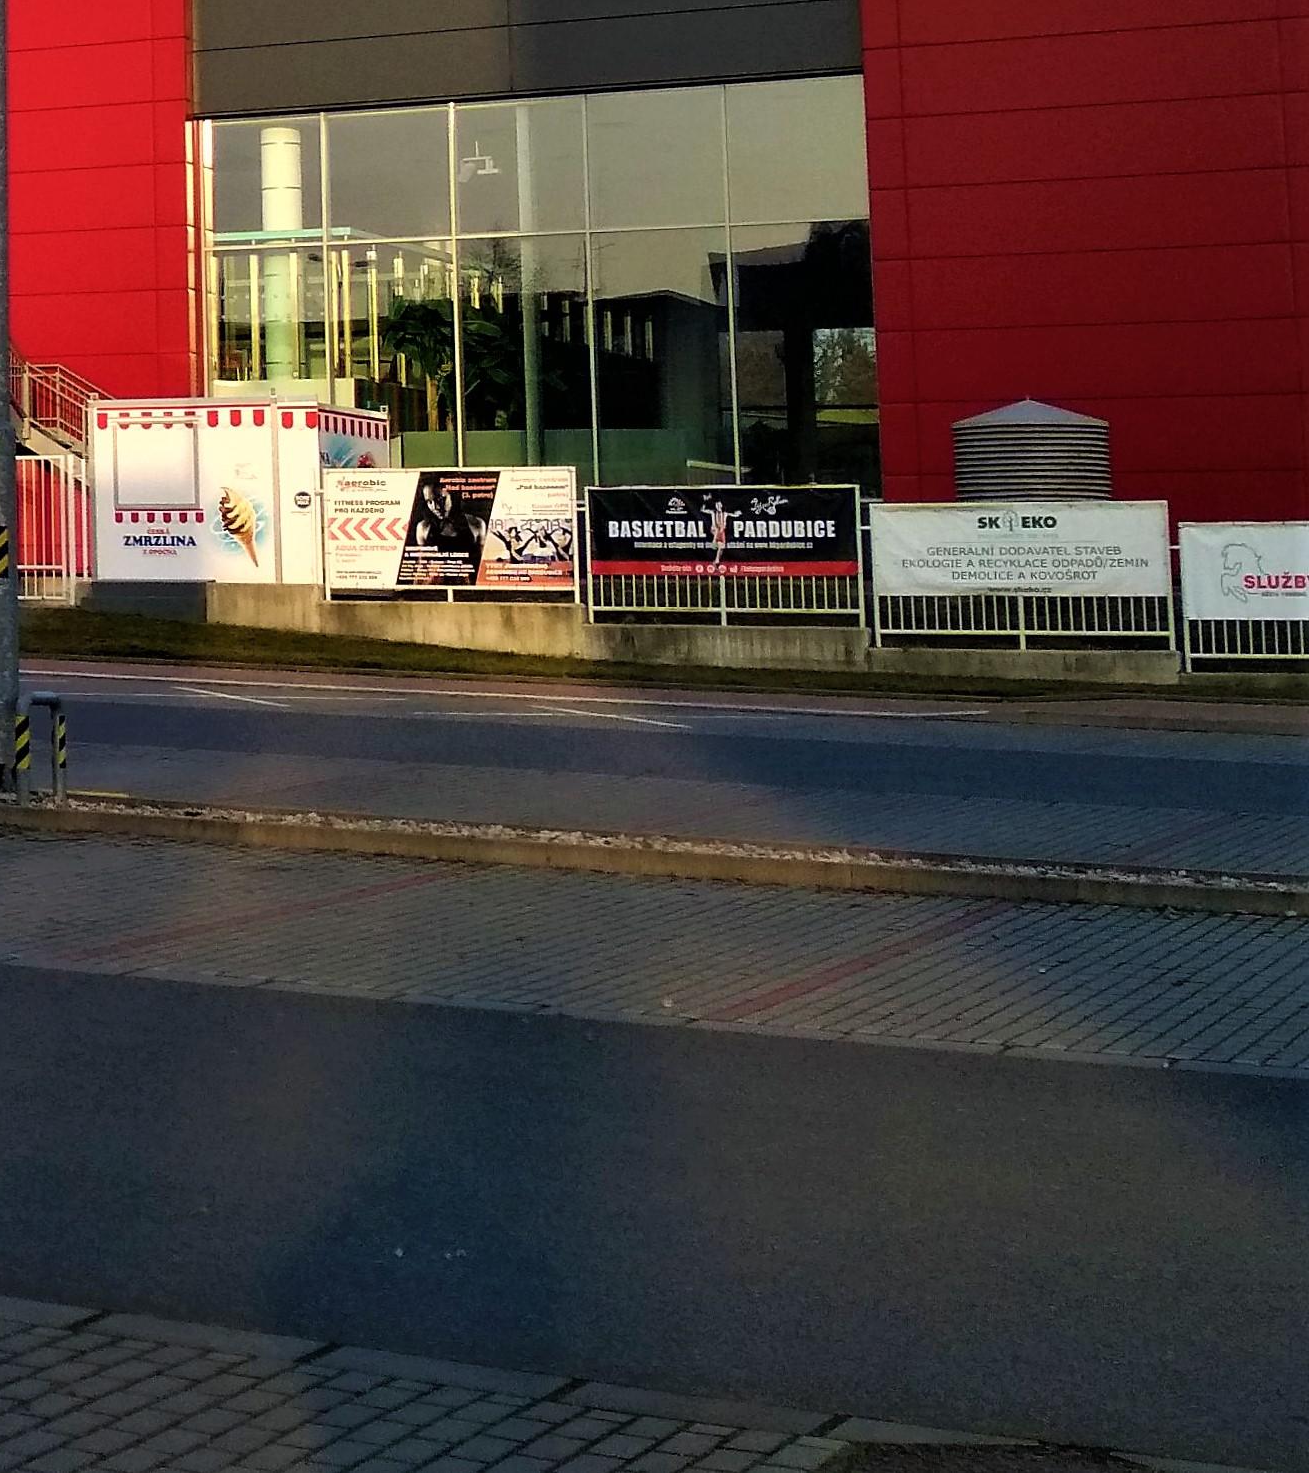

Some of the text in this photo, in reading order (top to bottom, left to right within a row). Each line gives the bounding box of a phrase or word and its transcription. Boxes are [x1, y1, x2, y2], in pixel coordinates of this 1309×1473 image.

[977, 516, 1057, 529] SK EKO
[608, 520, 837, 538] BASKETBAL PARDUBICE
[123, 535, 197, 547] ZMRZLINA
[999, 546, 1071, 556] DODAVATEL
[1075, 546, 1122, 556] STAVEB
[901, 559, 962, 568] EKOLOGIE
[966, 559, 976, 568] A
[979, 558, 1048, 568] RECYKLACE
[952, 568, 1098, 580] DEMOLICE A KOVOŠROT
